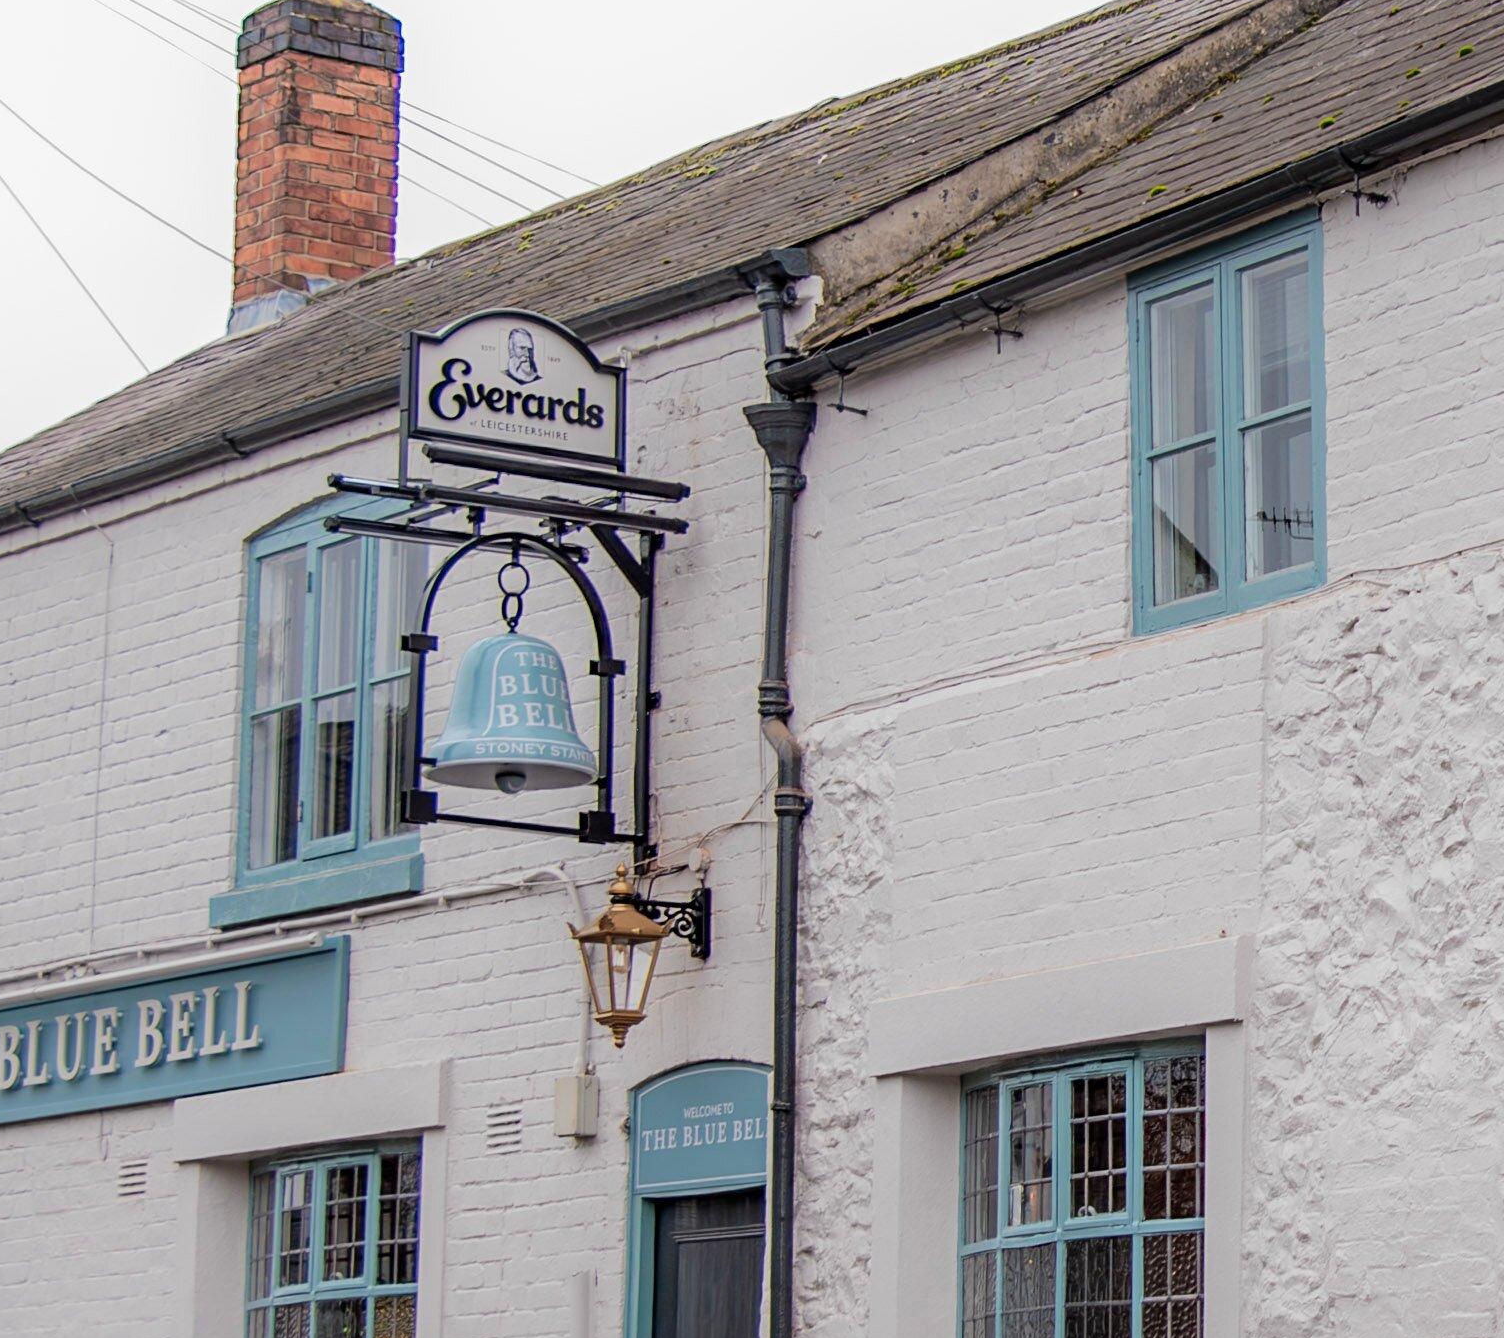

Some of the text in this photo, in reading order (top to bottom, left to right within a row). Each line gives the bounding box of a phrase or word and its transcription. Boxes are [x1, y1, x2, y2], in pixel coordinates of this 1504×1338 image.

[428, 357, 605, 429] Everards
[480, 419, 569, 441] LEICESTERSHIRE
[514, 651, 559, 670] THE
[475, 742, 547, 755] STONEY
[134, 980, 263, 1068] BELL
[683, 1102, 735, 1119] WELCOME TO
[641, 1117, 768, 1152] THE BLUE BEL
